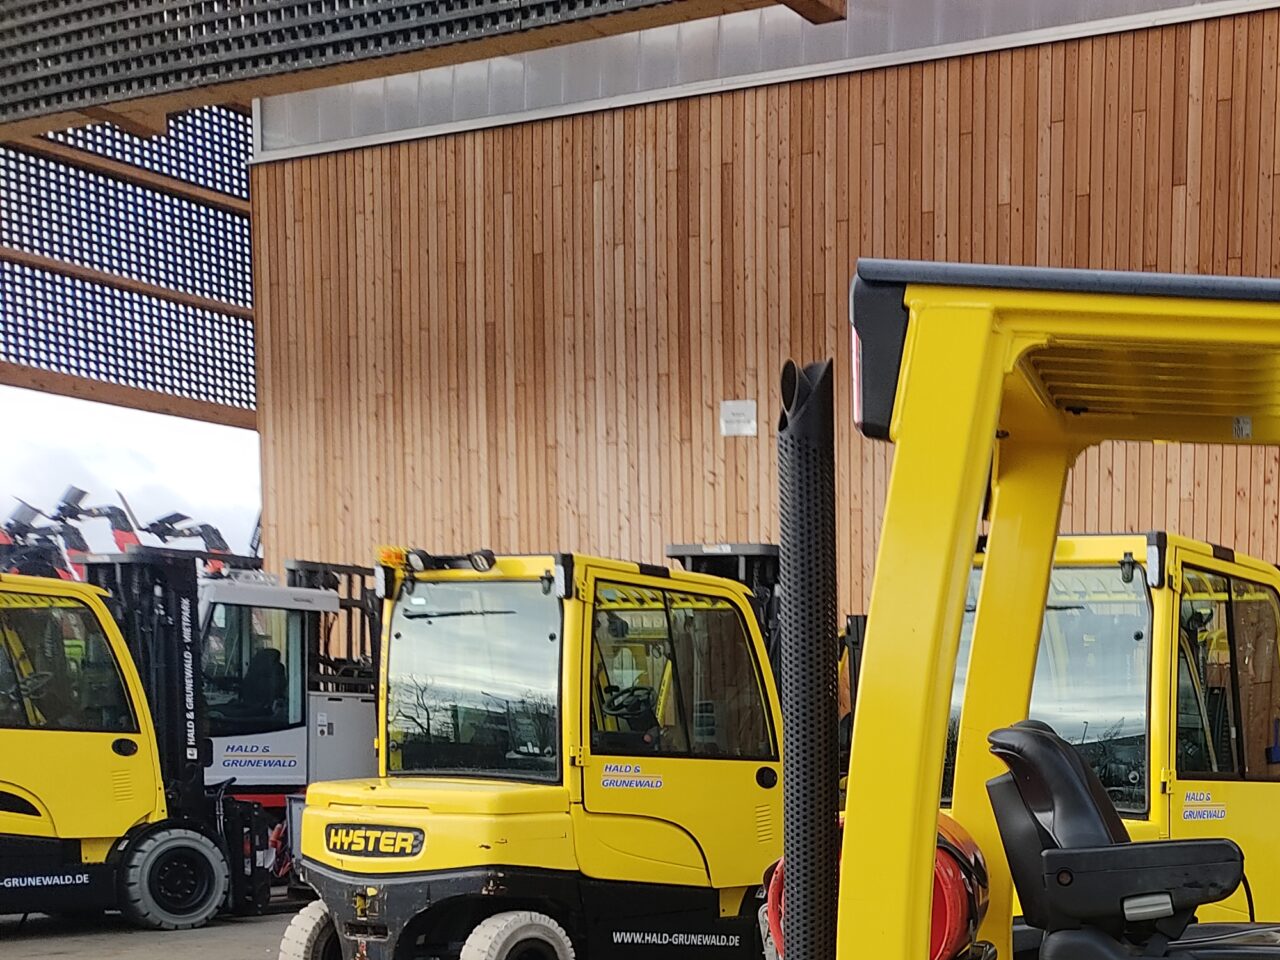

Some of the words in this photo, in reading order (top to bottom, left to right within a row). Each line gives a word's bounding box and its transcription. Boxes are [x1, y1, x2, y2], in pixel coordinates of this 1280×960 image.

[183, 650, 195, 710] GRUNEWALD
[186, 711, 195, 720] &
[186, 721, 196, 746] HALD
[225, 745, 259, 753] HALD
[222, 759, 297, 768] GRUNEWALD
[604, 764, 632, 773] HALD
[601, 779, 663, 789] GRUNEWALD
[1185, 792, 1205, 802] HALD
[1183, 809, 1226, 820] GRUNEWALD
[329, 828, 415, 854] HYSTER
[612, 931, 740, 947] WWW.HALD-GRUNEWALD.DE
